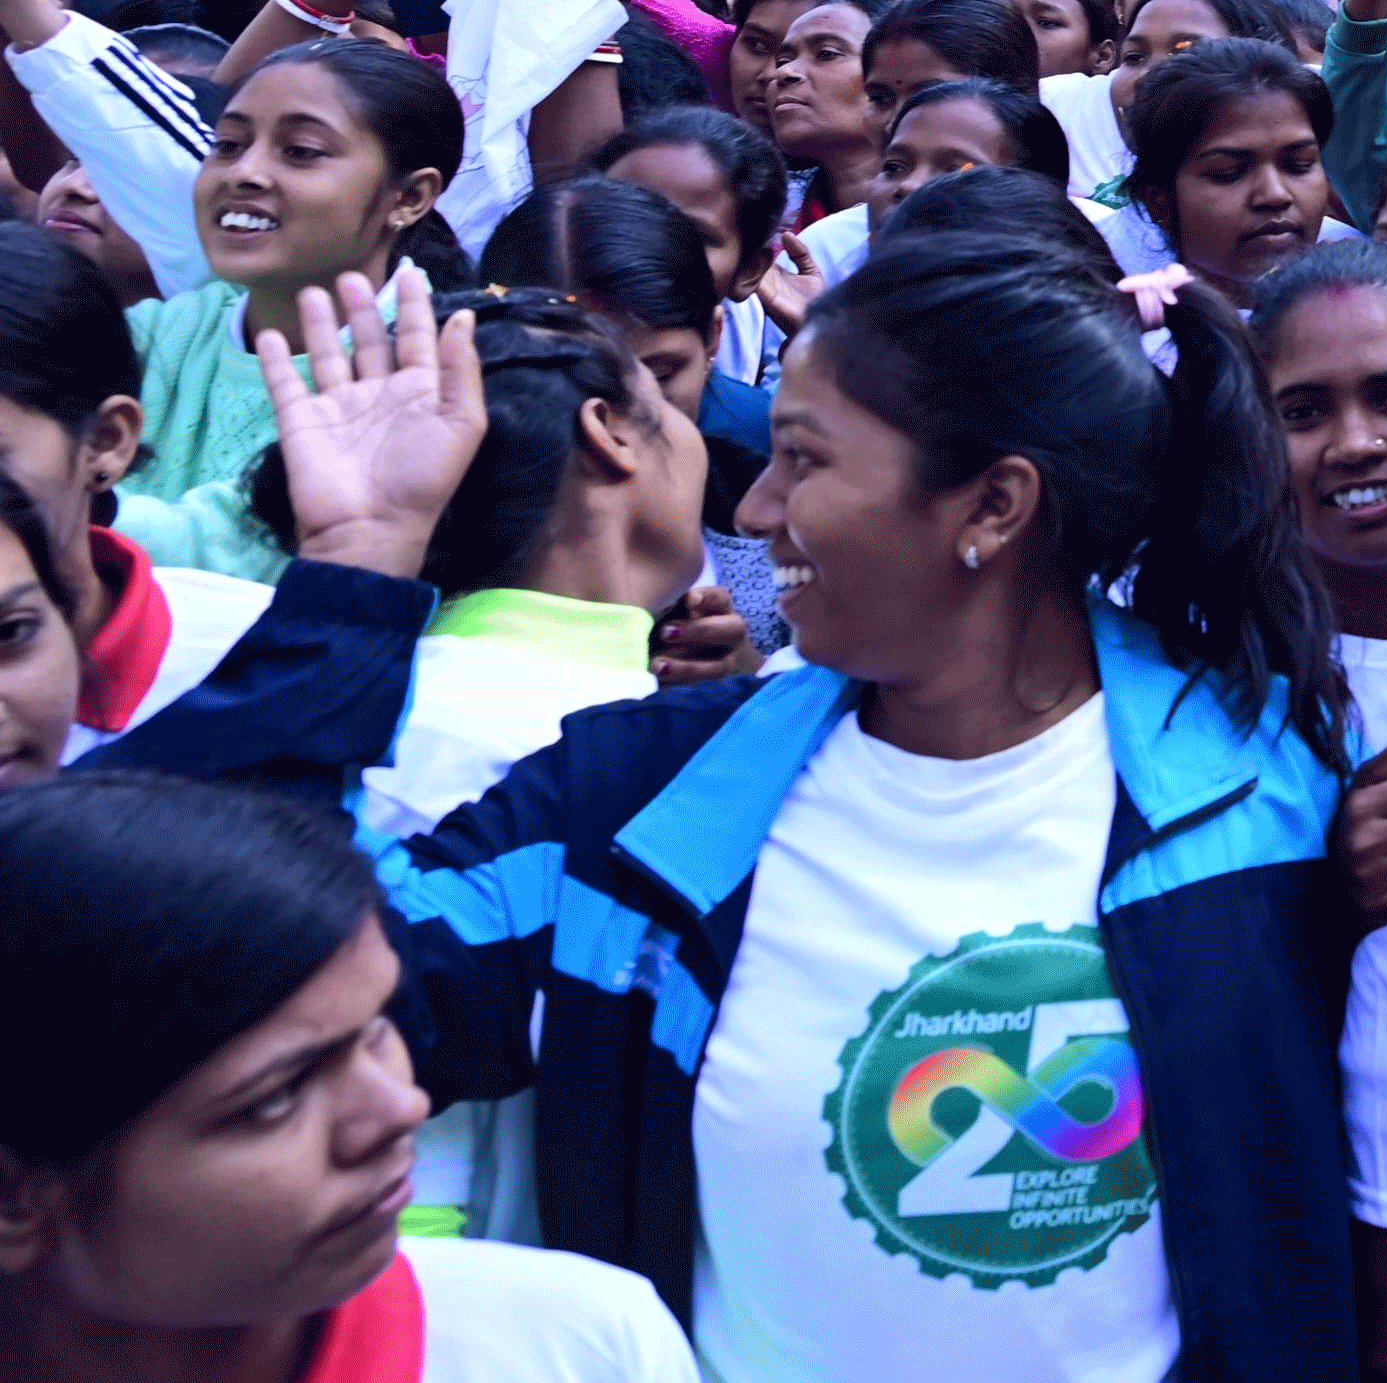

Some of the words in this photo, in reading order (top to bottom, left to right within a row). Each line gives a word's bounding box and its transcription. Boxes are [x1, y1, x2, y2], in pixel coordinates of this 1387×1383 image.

[895, 1006, 1033, 1039] Jharkhand
[1016, 1165, 1099, 1191] EXPLORE
[1012, 1185, 1089, 1209] INFINITE
